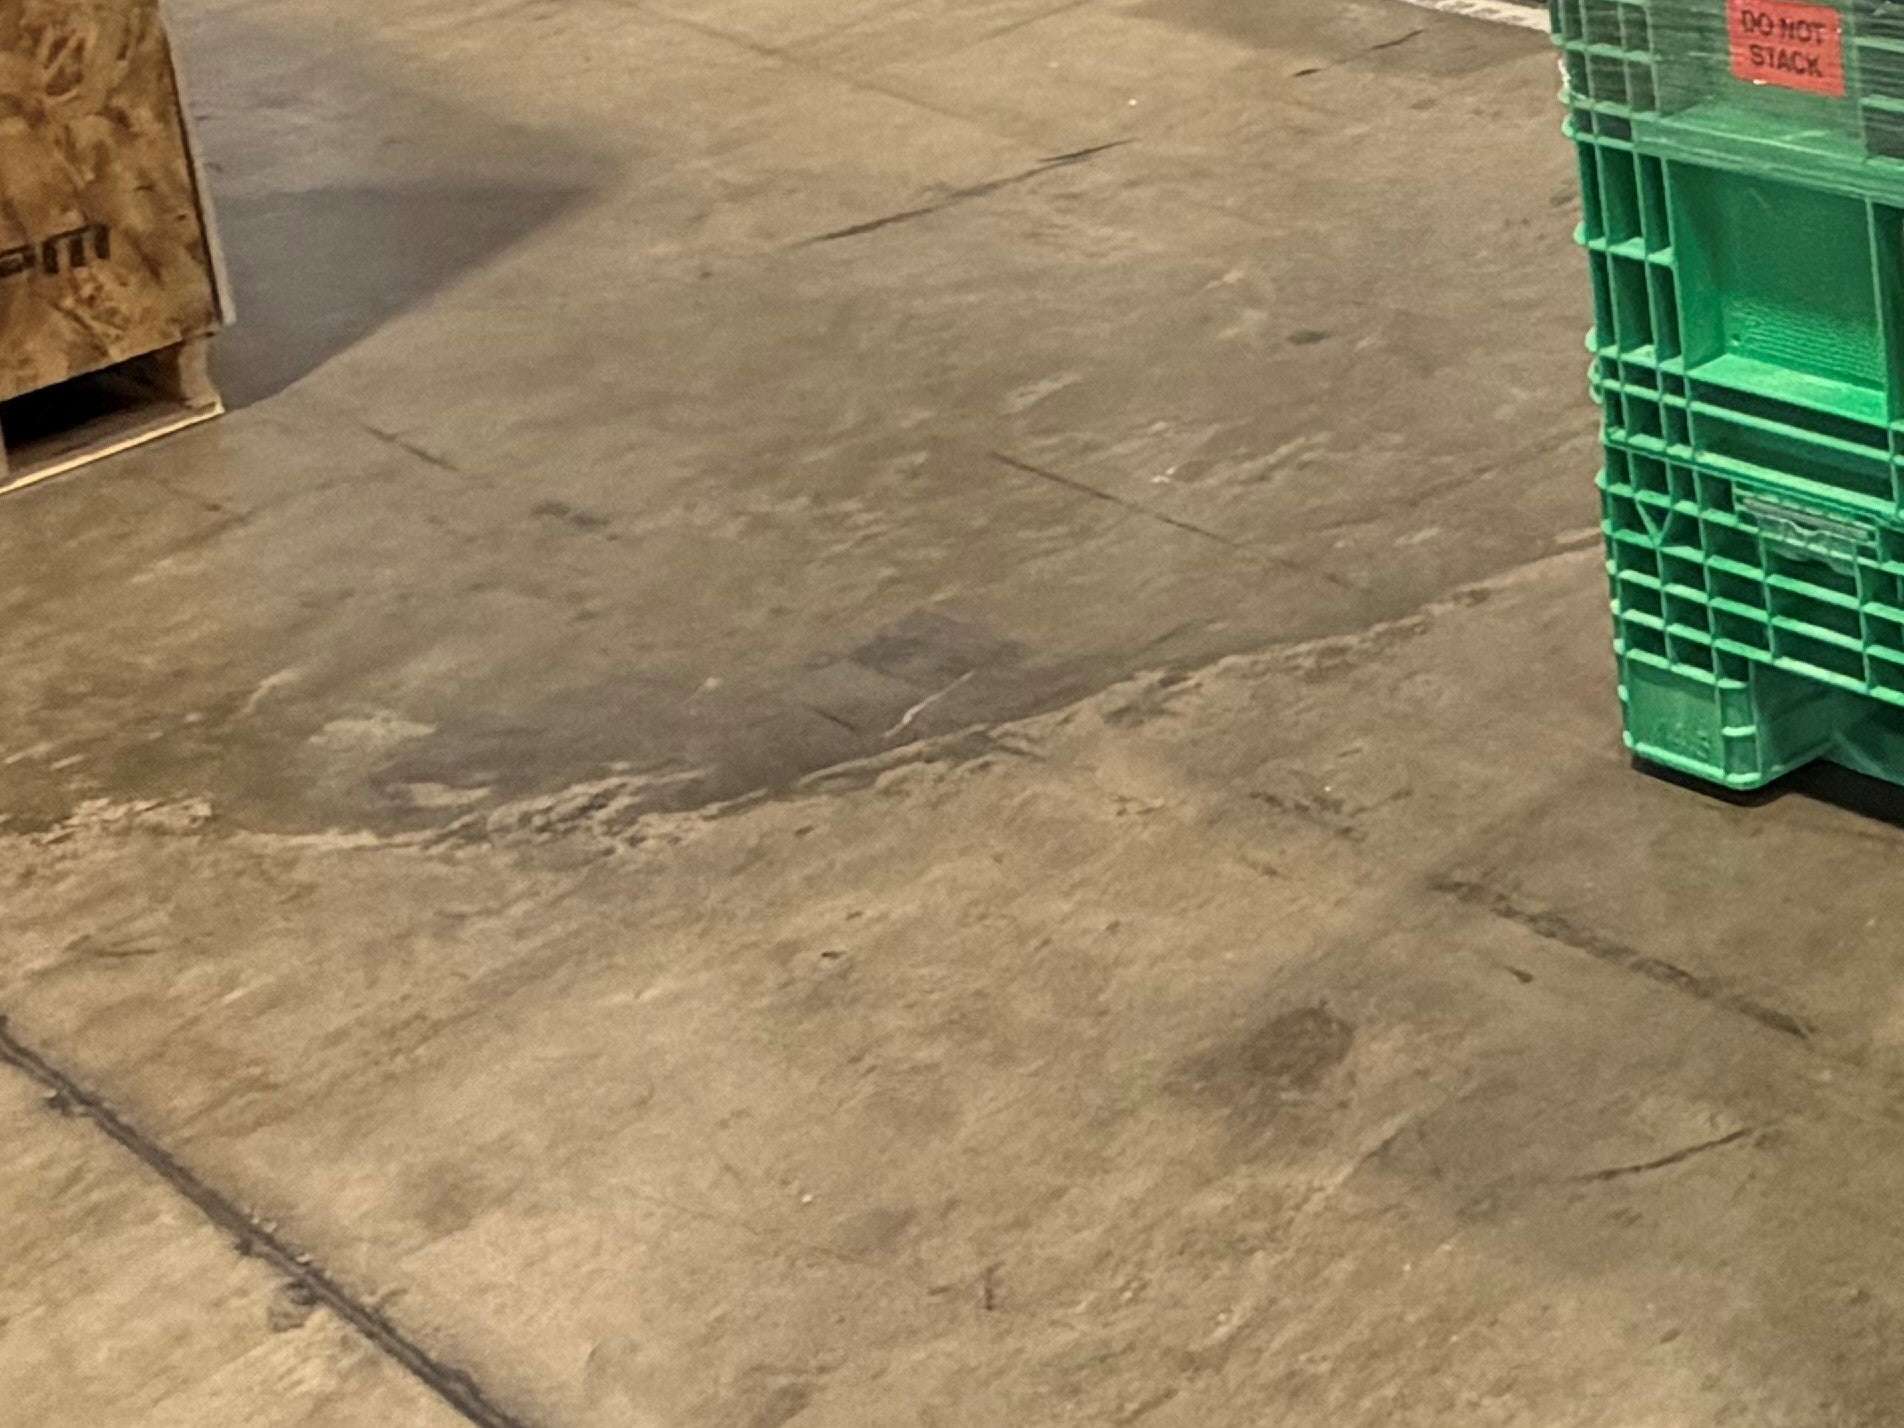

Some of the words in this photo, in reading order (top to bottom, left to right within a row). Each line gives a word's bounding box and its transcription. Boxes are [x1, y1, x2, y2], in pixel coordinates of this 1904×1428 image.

[1741, 10, 1773, 34] DO
[1784, 16, 1826, 46] NOT
[1748, 40, 1822, 78] STACK
